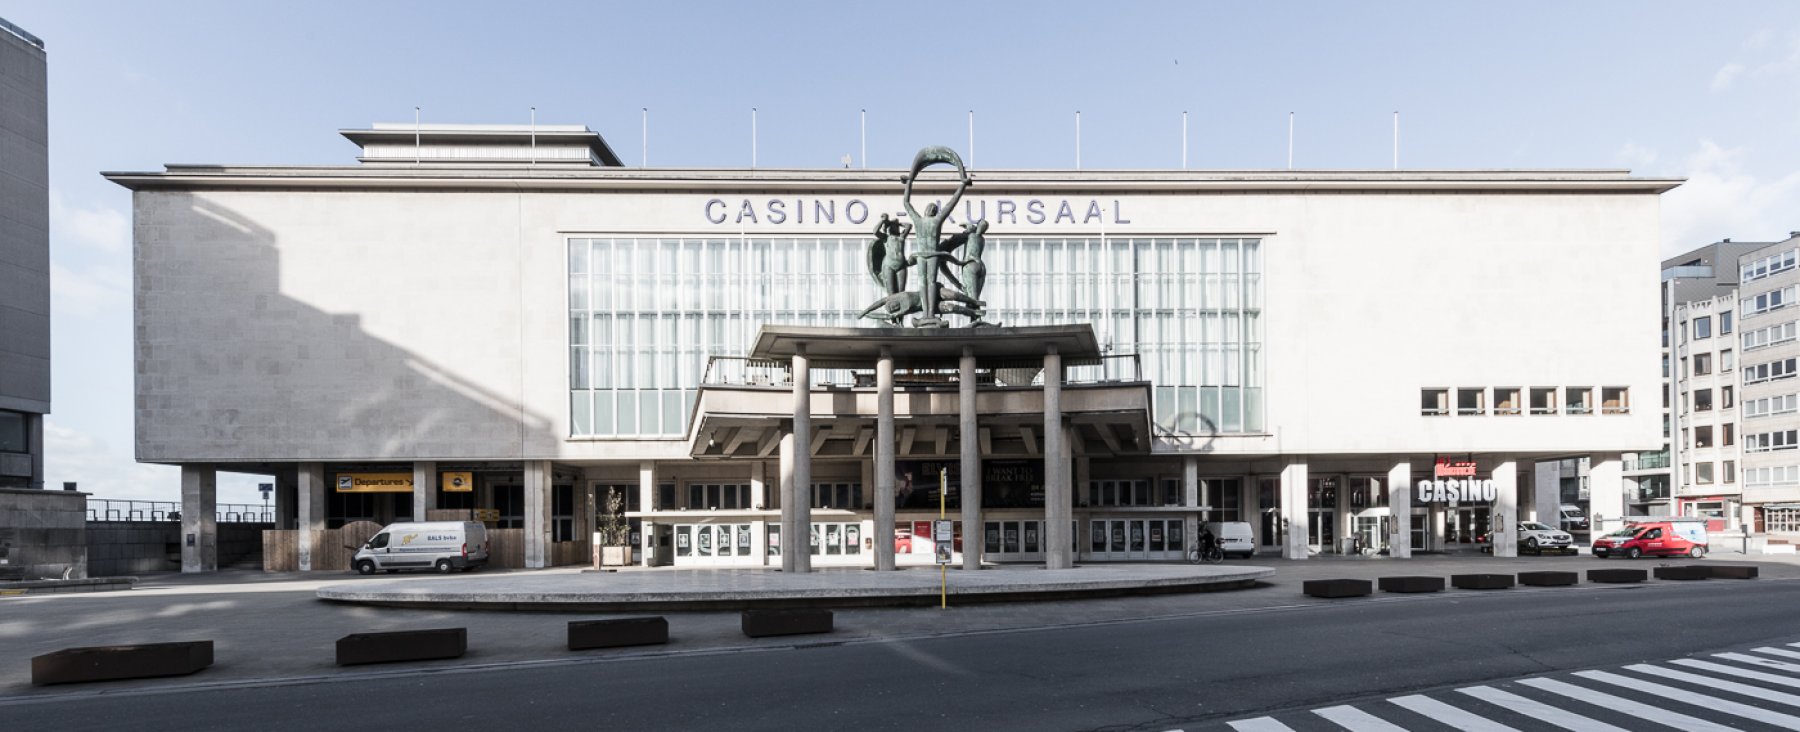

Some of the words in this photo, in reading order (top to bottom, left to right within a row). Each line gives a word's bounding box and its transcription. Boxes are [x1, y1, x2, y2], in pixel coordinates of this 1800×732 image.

[705, 199, 868, 224] CASINO
[355, 478, 403, 487] Departures
[1418, 479, 1497, 502] CASINO
